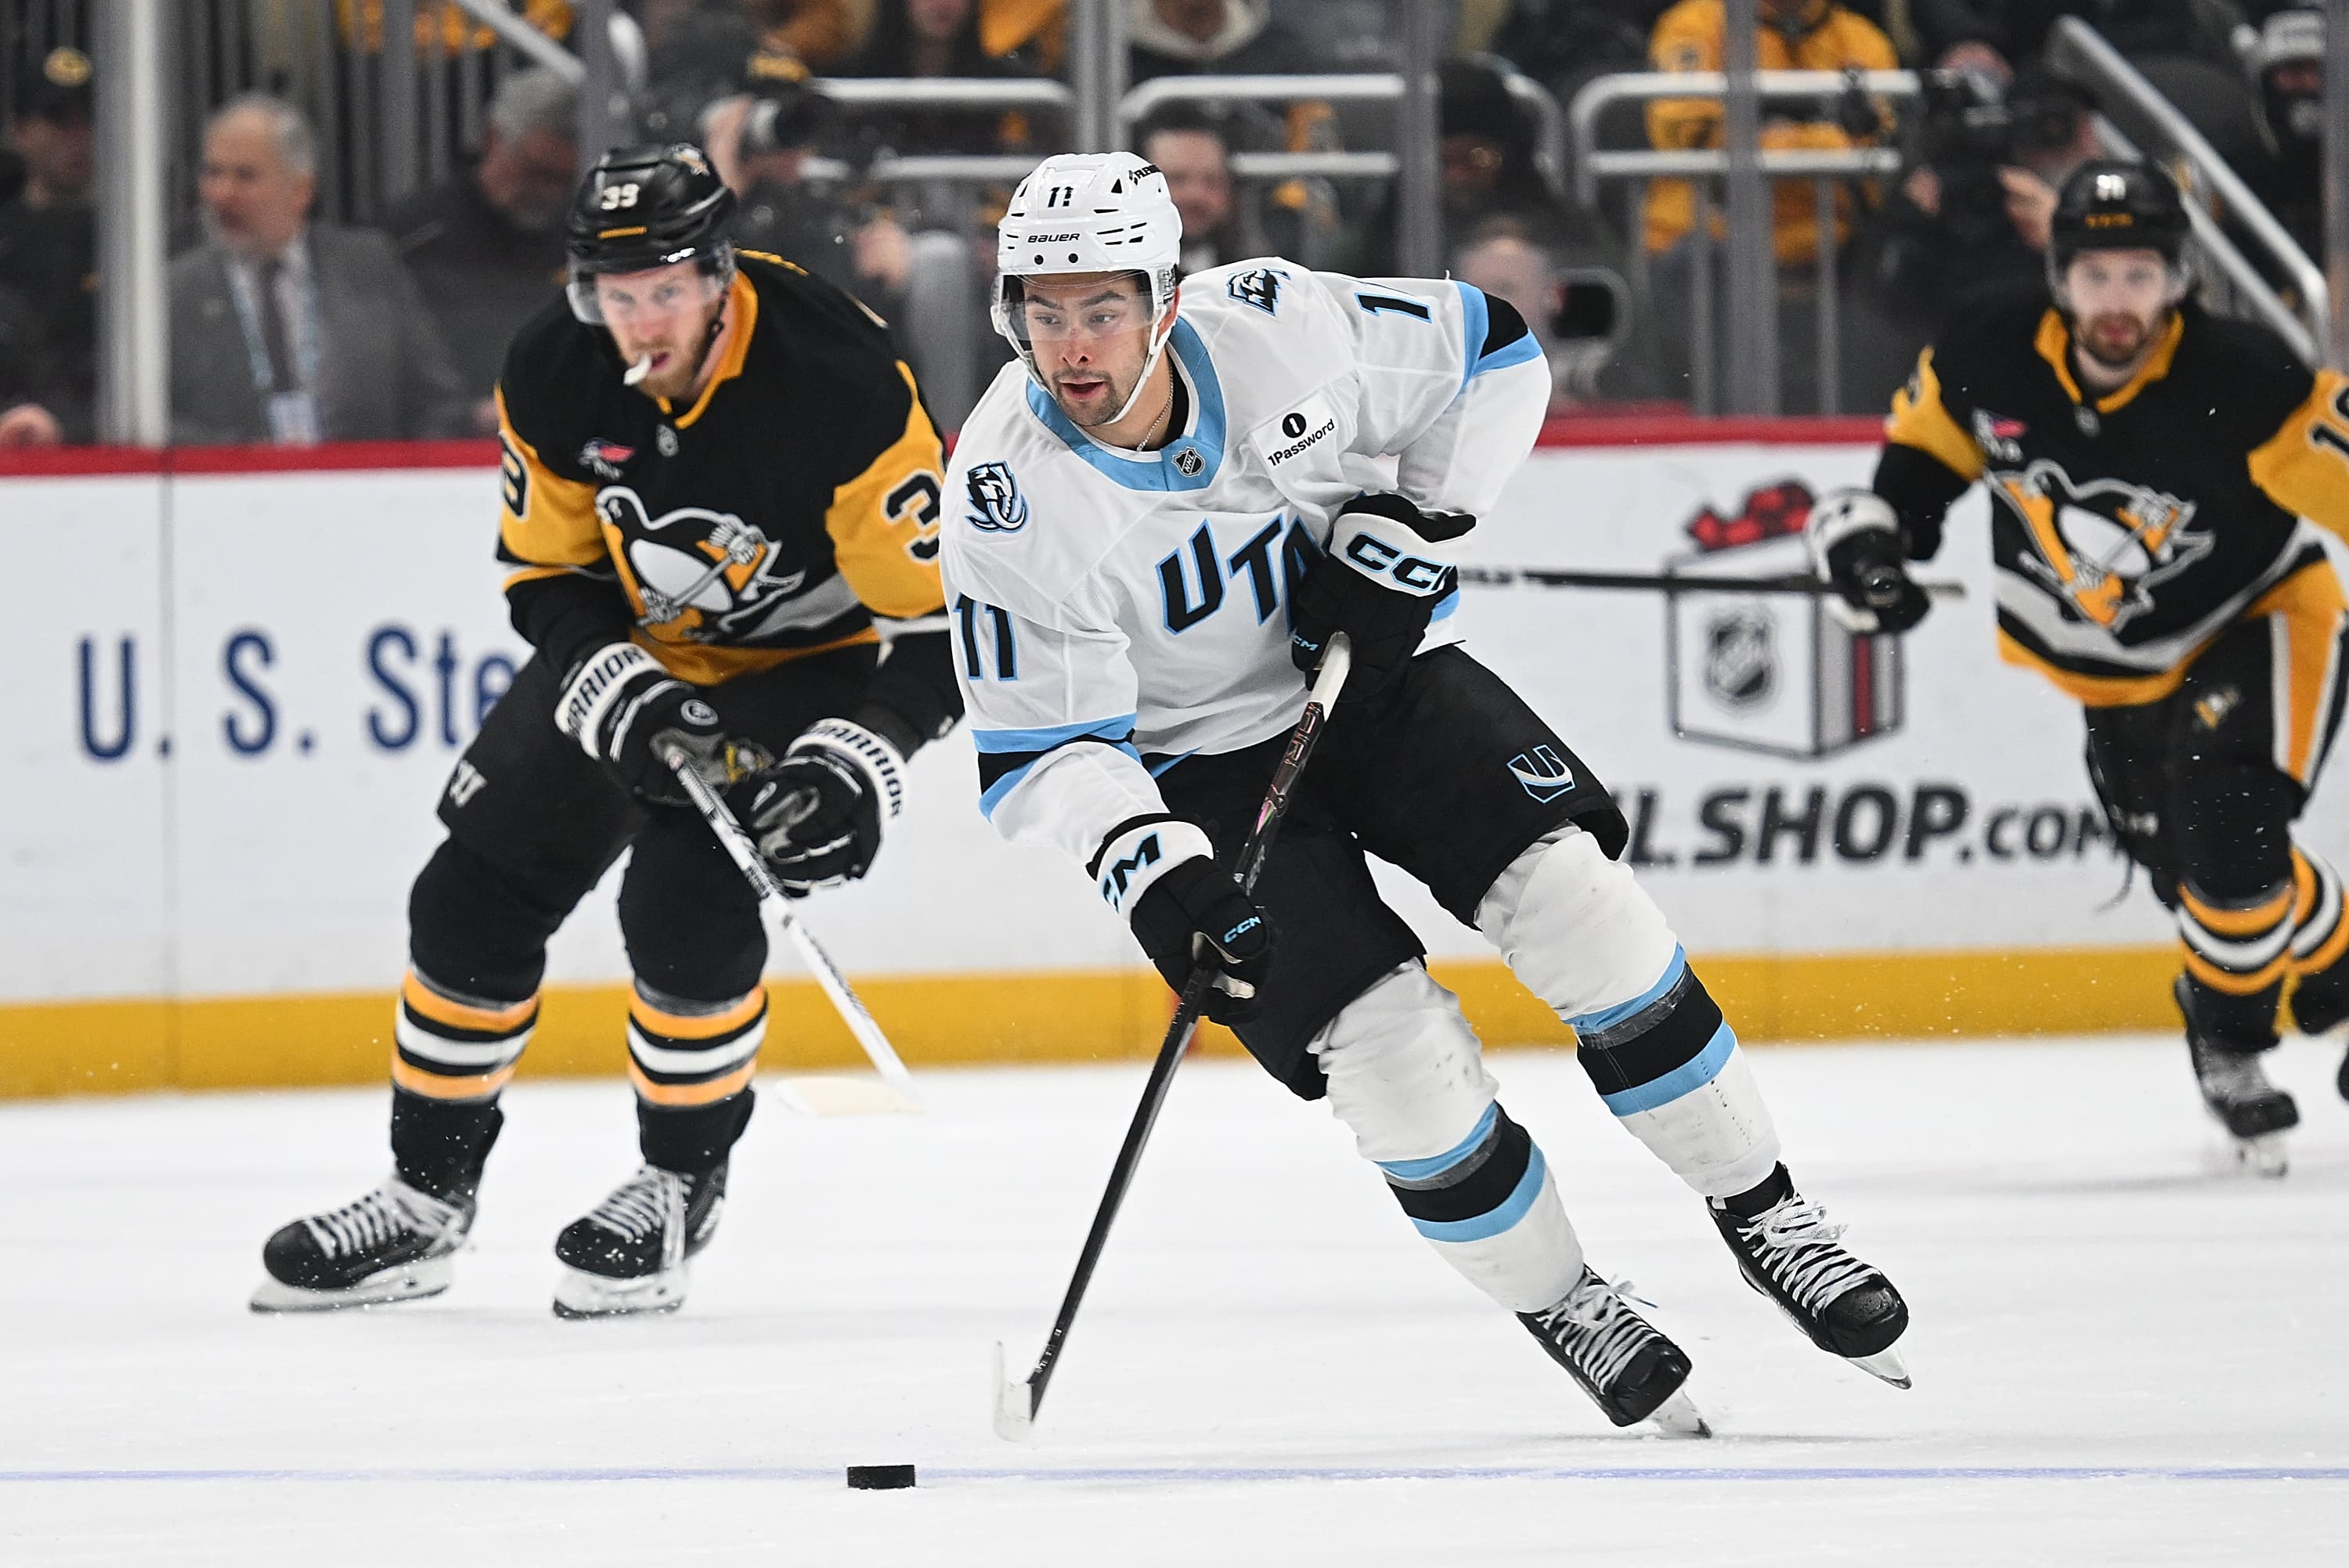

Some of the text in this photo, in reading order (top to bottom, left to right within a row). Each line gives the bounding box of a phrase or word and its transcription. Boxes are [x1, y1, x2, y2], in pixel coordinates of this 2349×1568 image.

[1047, 186, 1073, 207] 11
[1027, 232, 1081, 243] BAUER
[1267, 418, 1334, 467] 1Password
[953, 592, 1018, 681] 11
